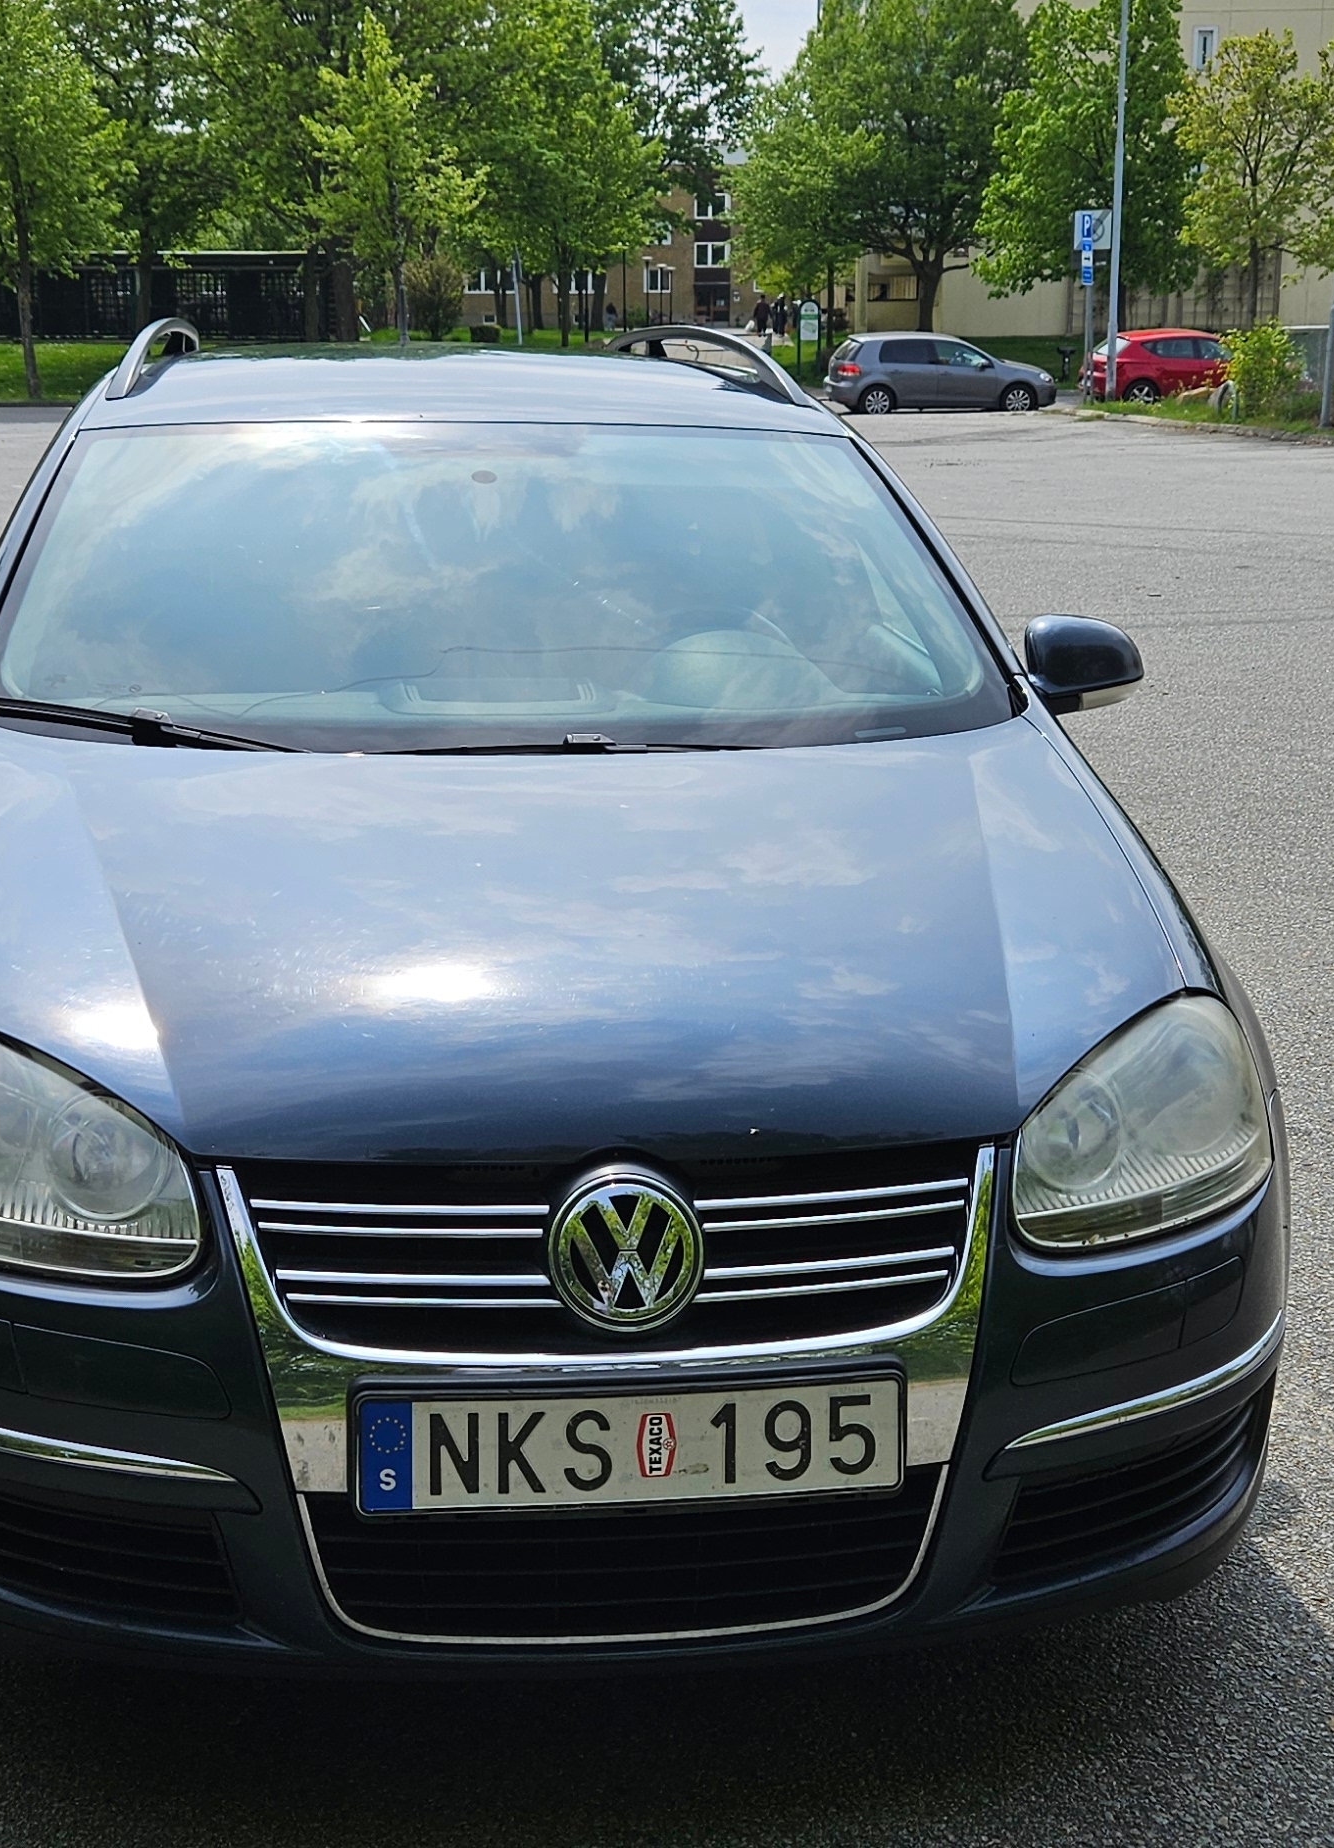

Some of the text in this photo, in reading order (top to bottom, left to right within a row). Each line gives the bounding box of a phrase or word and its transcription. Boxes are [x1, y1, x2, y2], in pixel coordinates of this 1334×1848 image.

[1084, 215, 1091, 237] P
[557, 1182, 696, 1323] VW
[429, 1394, 876, 1496] NKS 195
[648, 1415, 663, 1475] TEXACO
[379, 1468, 397, 1491] S
